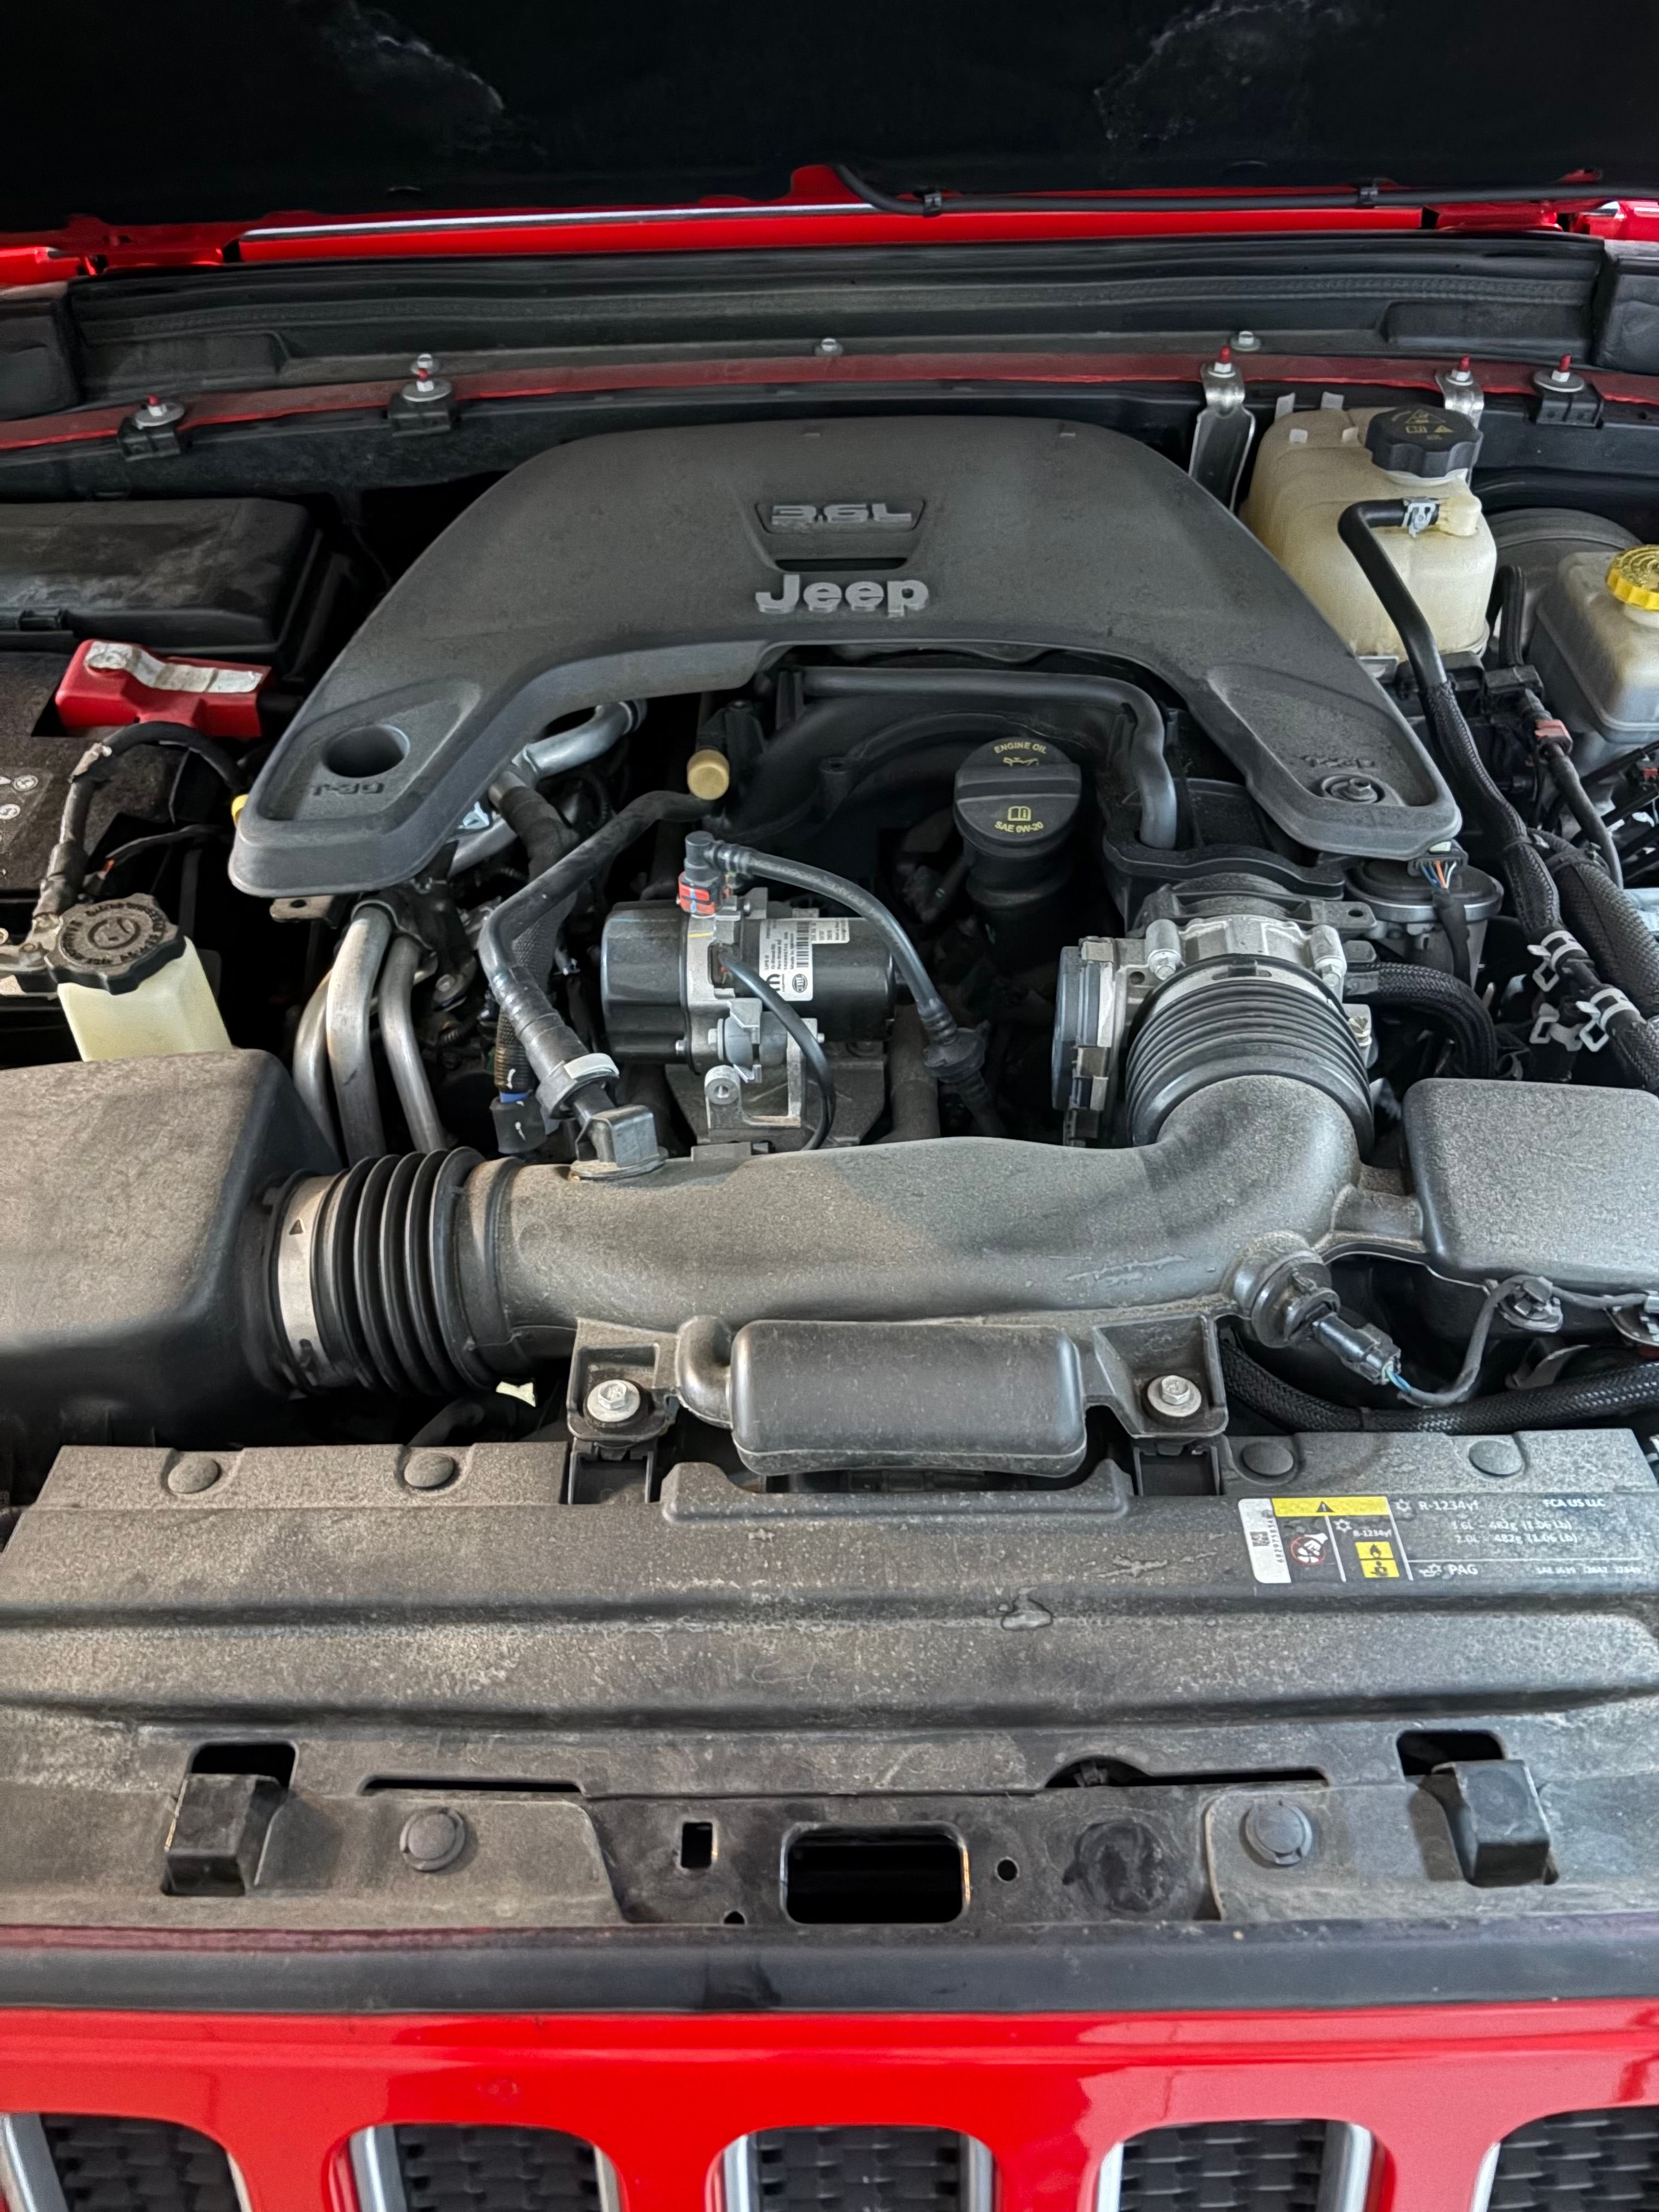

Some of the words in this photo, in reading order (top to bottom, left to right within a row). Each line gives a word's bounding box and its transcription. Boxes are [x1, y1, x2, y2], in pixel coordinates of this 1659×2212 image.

[771, 503, 912, 525] 3.6L
[755, 574, 929, 619] Jeep
[994, 742, 1030, 754] ENGINE
[1032, 743, 1047, 754] OIL
[994, 821, 1014, 833] SAE
[1015, 821, 1043, 833] 0W-20
[1542, 1498, 1567, 1508] FCA
[1567, 1498, 1585, 1507] US
[1585, 1498, 1606, 1507] LLC
[1448, 1564, 1479, 1576] PAG
